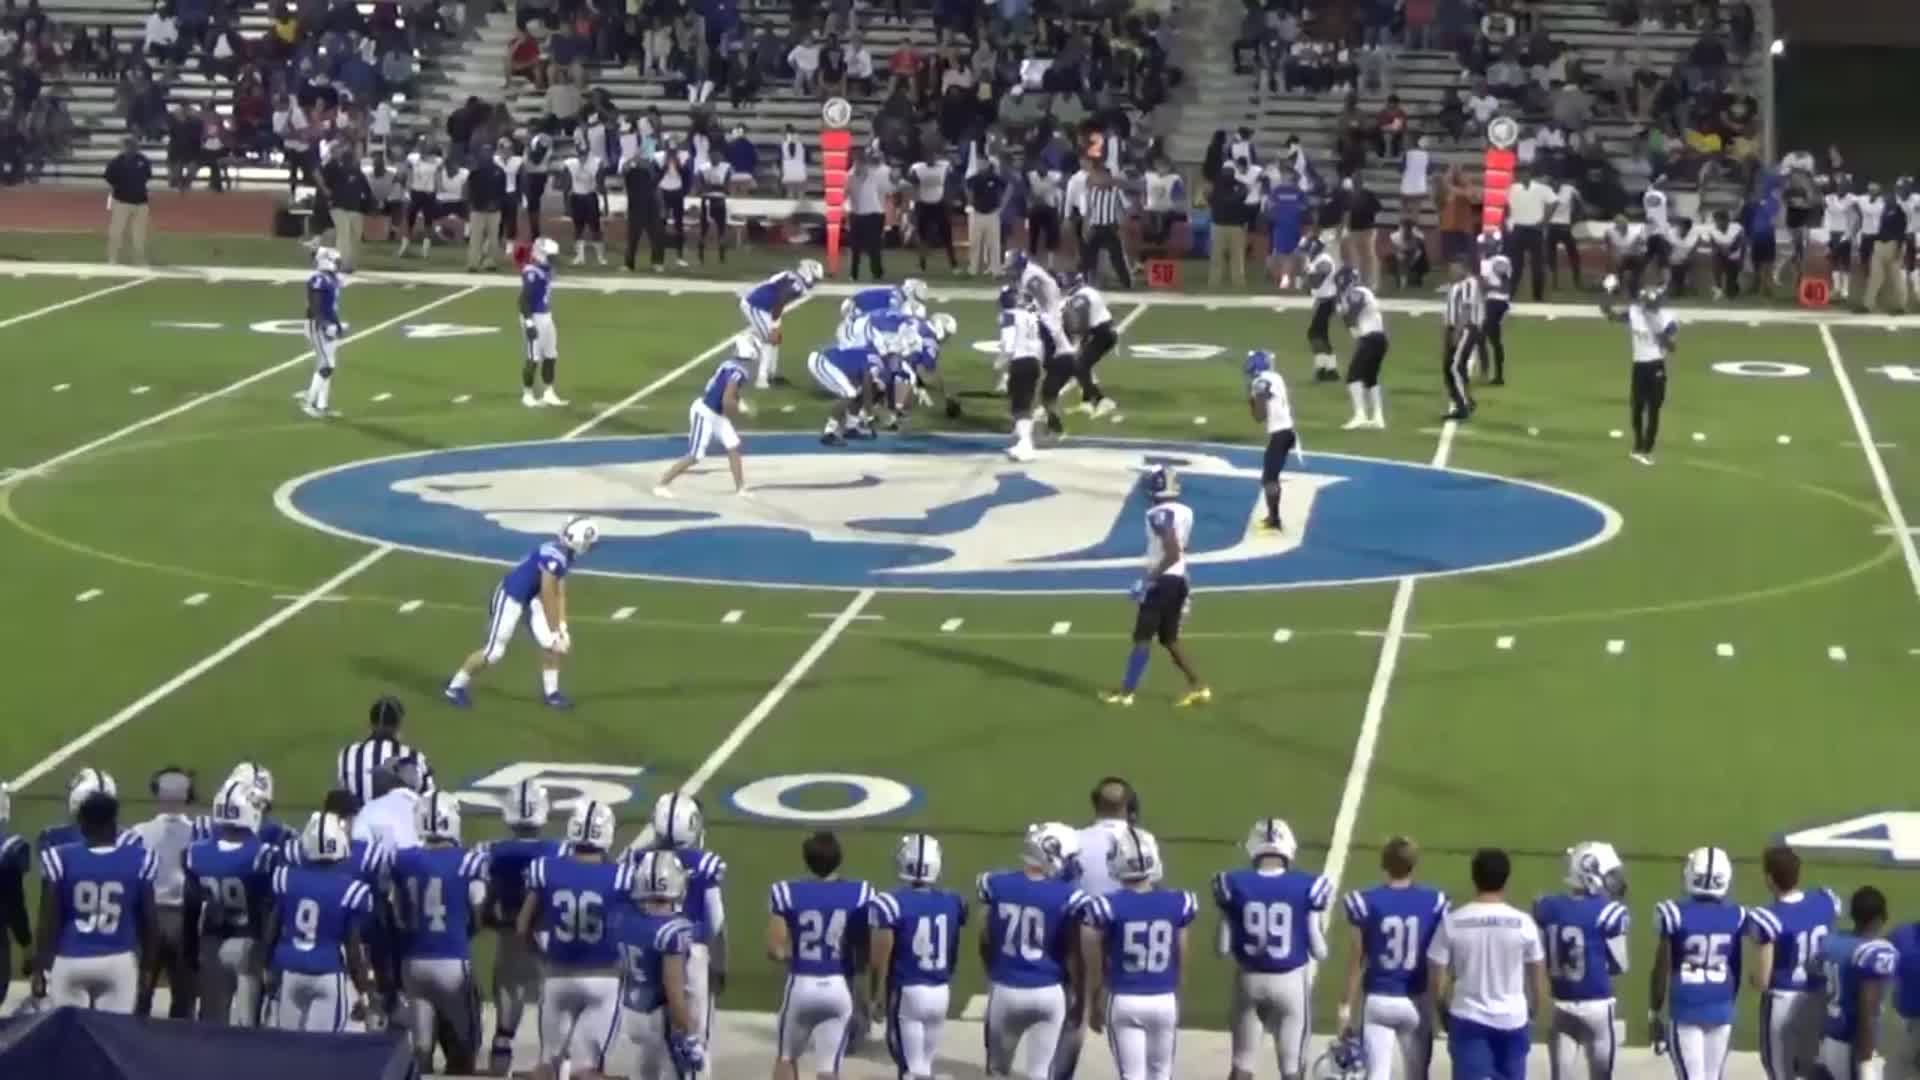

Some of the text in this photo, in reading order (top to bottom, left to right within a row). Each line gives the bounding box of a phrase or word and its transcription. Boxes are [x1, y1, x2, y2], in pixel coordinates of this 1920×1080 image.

[74, 880, 125, 934] 96
[294, 899, 320, 951] 9
[406, 877, 447, 931] 14
[552, 890, 603, 942] 36
[1243, 902, 1293, 959] 99
[799, 909, 847, 960] 24
[912, 913, 948, 970] 41
[998, 903, 1044, 961] 70
[1122, 920, 1173, 973] 58
[1380, 916, 1419, 970] 31
[1548, 925, 1585, 982] 13
[1681, 934, 1731, 984] 25
